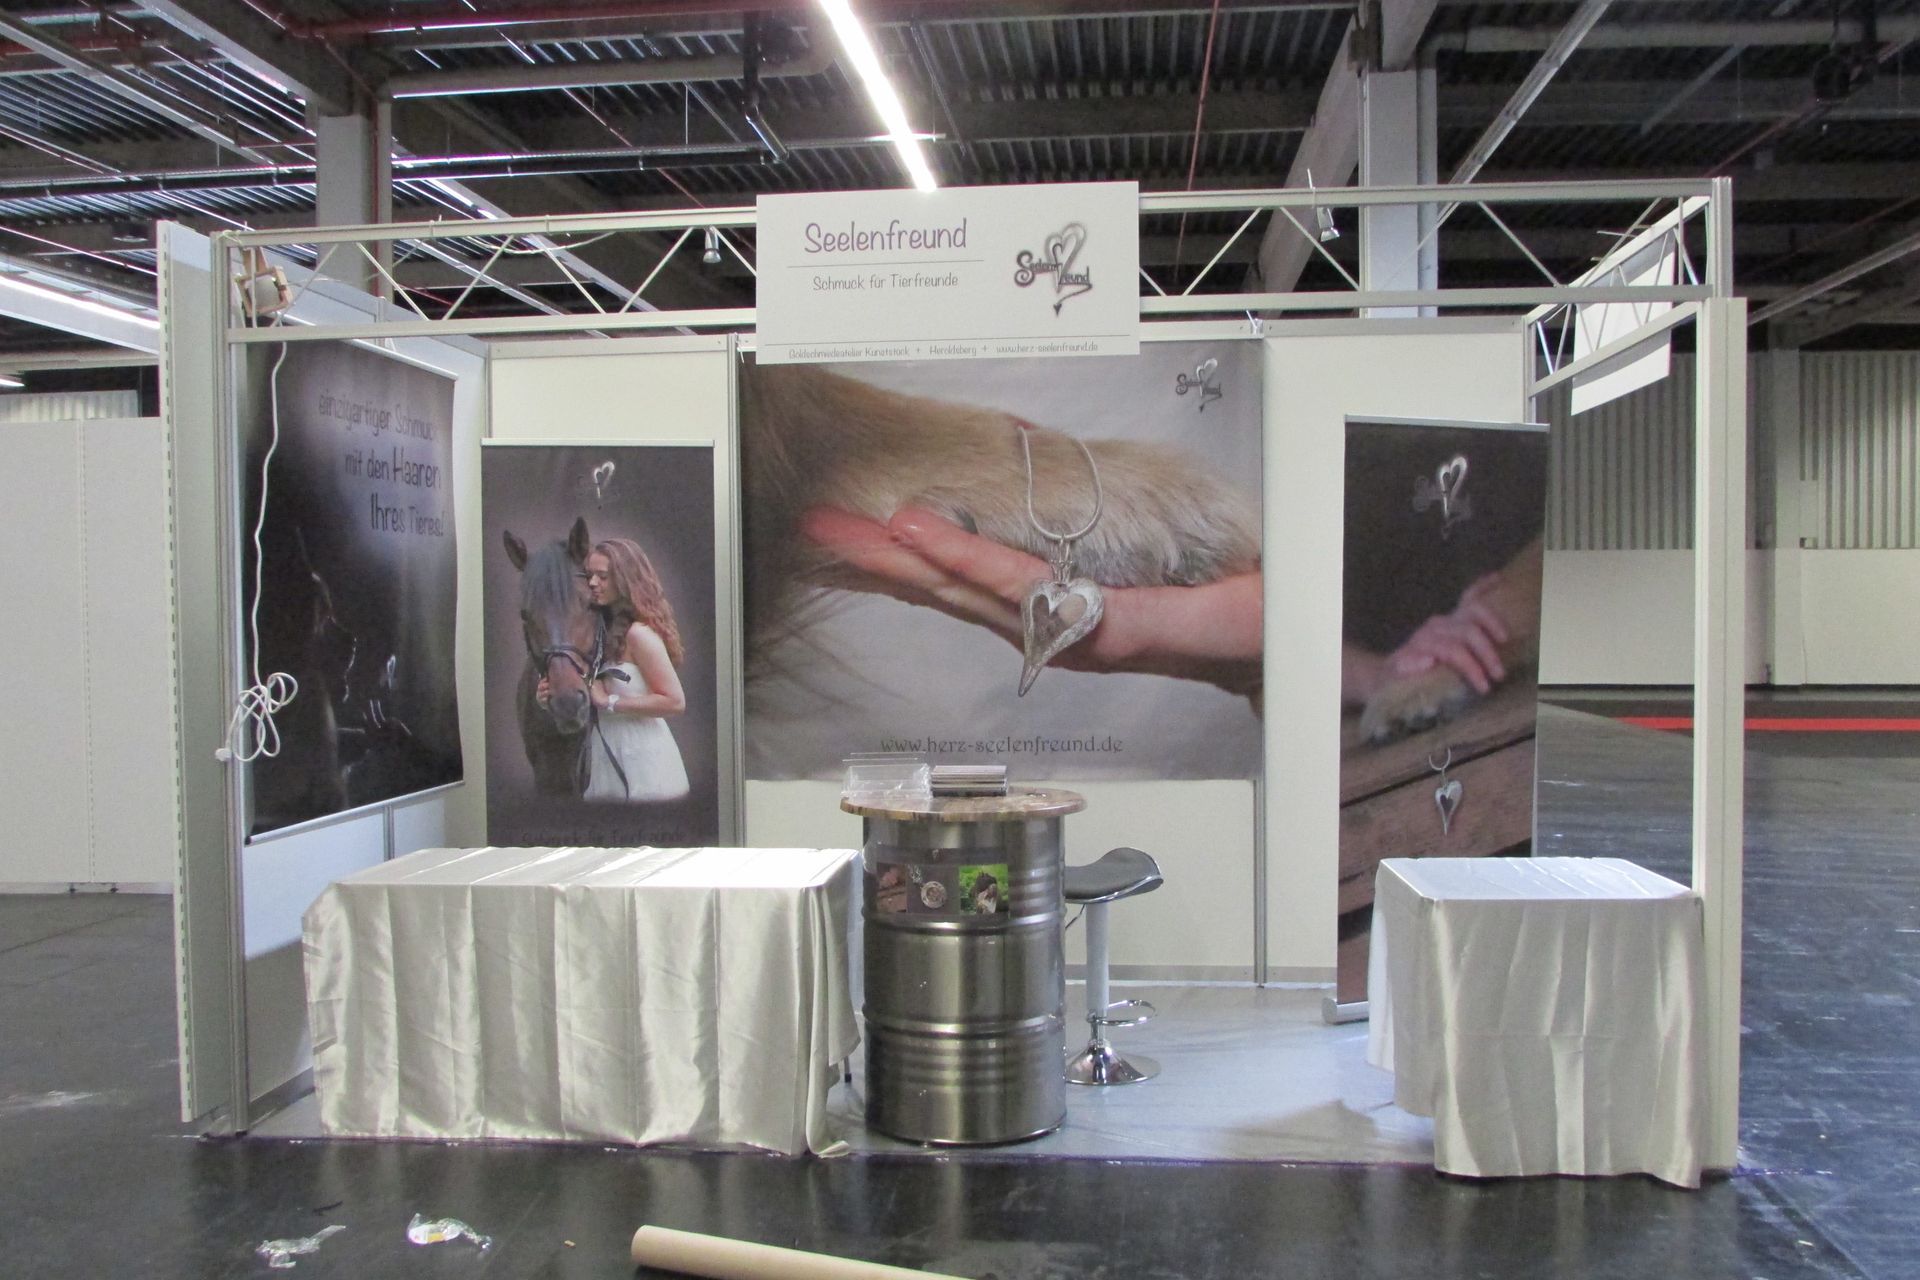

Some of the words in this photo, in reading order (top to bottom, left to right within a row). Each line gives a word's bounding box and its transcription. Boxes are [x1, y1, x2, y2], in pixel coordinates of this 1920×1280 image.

[804, 218, 967, 253] Seelenfreund
[813, 276, 864, 291] Schmuck
[869, 274, 885, 289] für
[891, 273, 959, 288] Tierfreunde
[319, 389, 391, 437] einzigartiger
[396, 404, 434, 441] Schmuc
[345, 451, 362, 476] mit
[367, 450, 390, 480] den
[393, 446, 441, 489] Haaren
[371, 493, 405, 534] Ihres
[408, 506, 445, 537] Tieres!
[881, 735, 1123, 755] www.herz-seelenfreund.de
